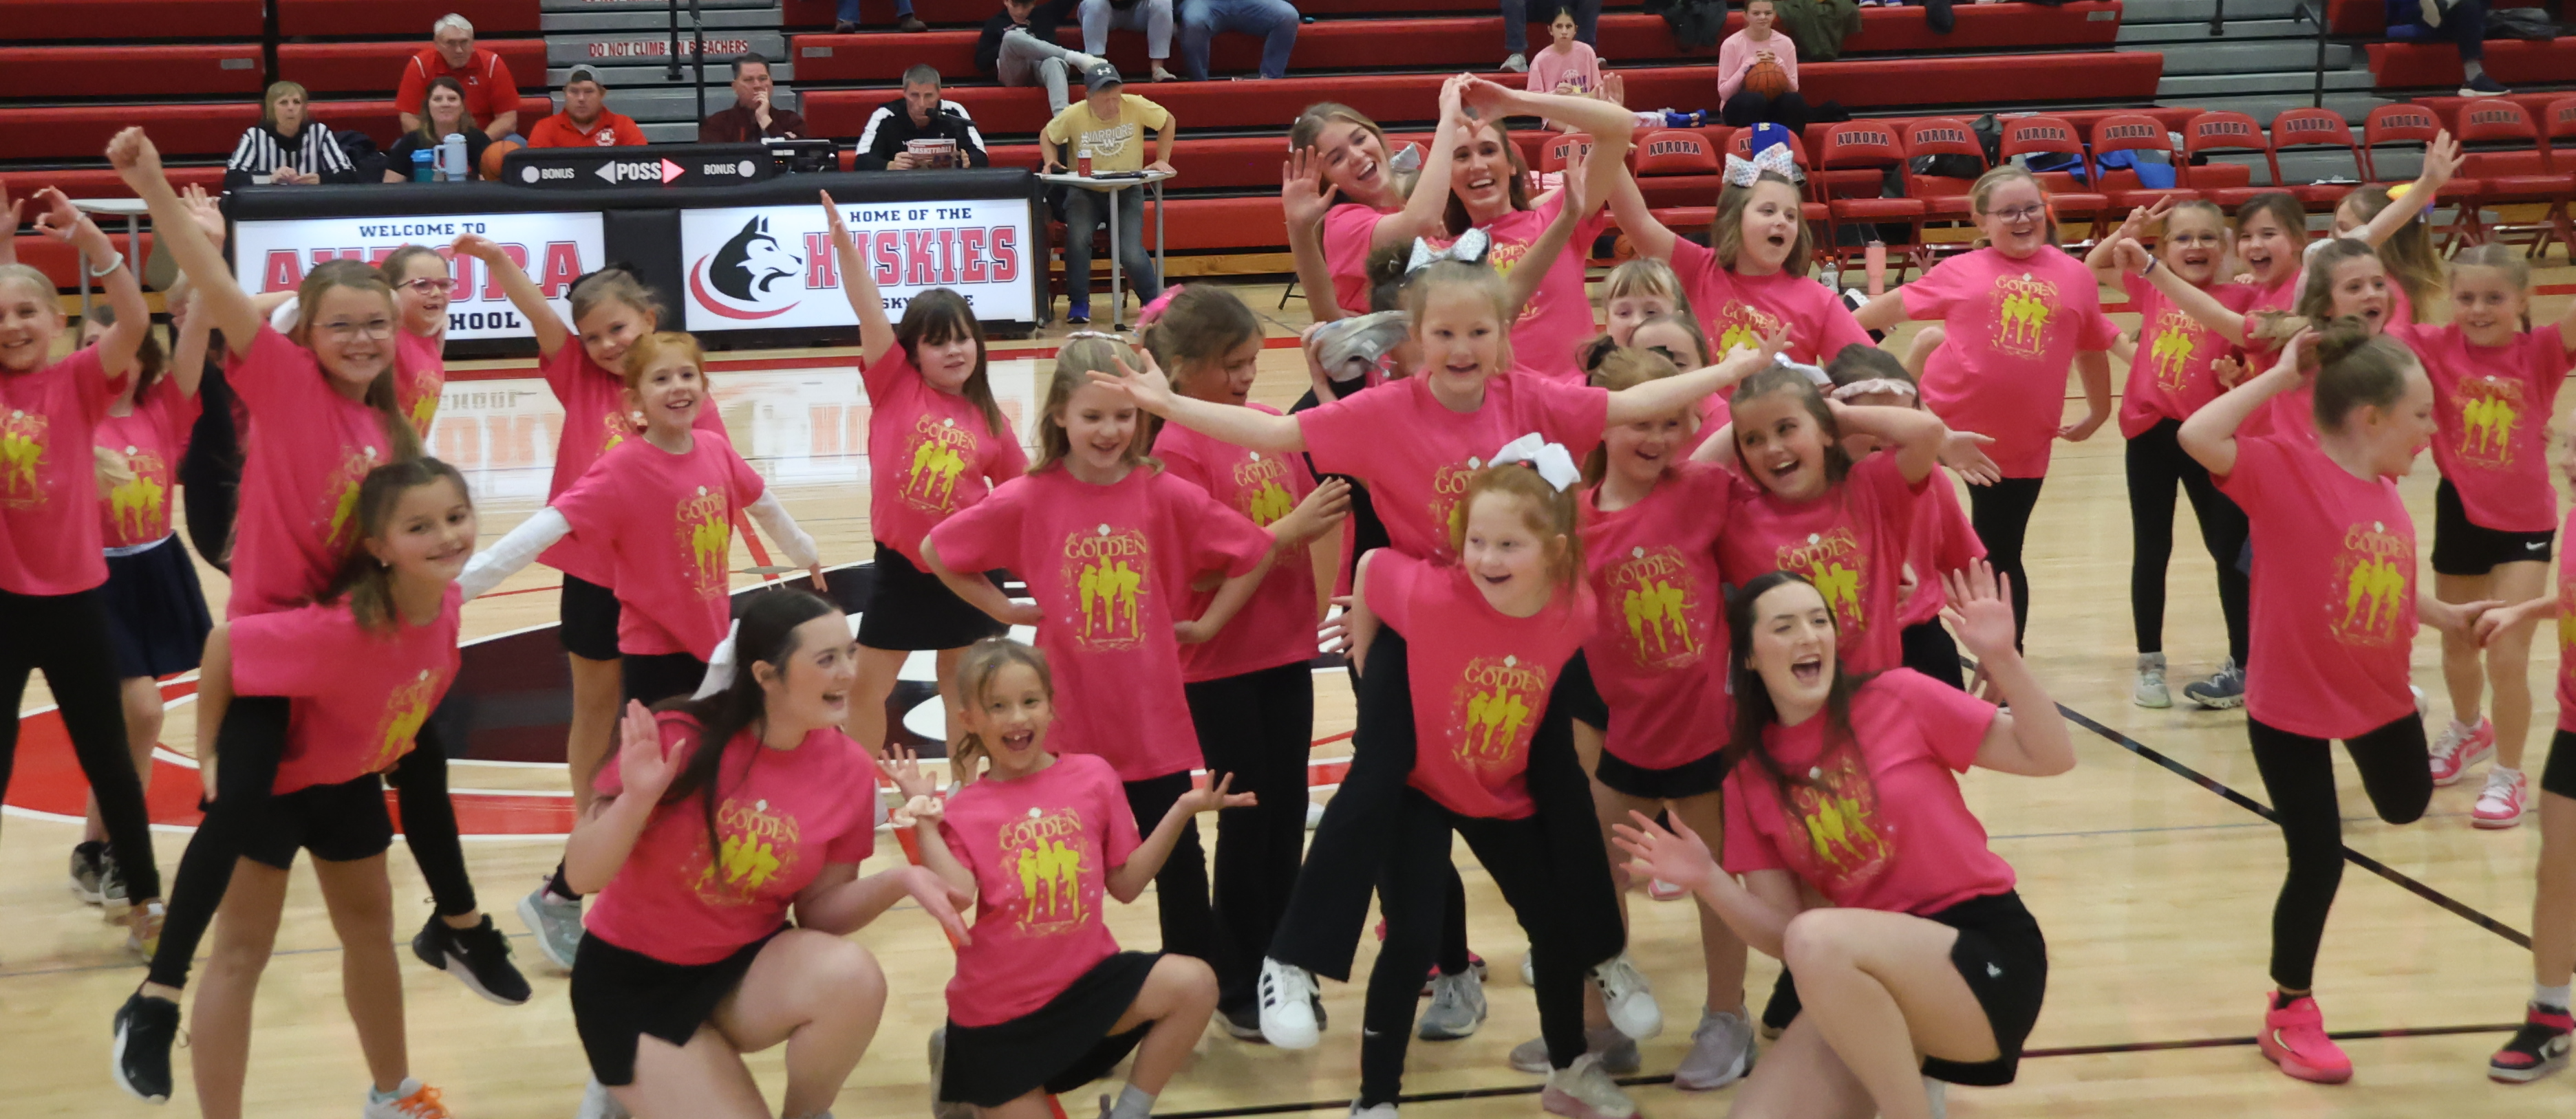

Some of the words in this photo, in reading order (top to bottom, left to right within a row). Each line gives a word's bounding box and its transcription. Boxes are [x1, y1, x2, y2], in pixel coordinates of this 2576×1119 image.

[589, 43, 603, 57] DO
[610, 42, 629, 56] NOT
[634, 41, 665, 56] CLIMB
[689, 40, 748, 55] BEACHERS
[1836, 131, 1889, 146] AURORA
[1915, 128, 1966, 144] AURORA
[2015, 127, 2066, 142] AURORA
[2105, 124, 2156, 140] AURORA
[1649, 140, 1702, 157] AURORA
[541, 168, 575, 180] BONUS
[616, 162, 662, 181] POSS
[703, 164, 736, 175] BONUS
[850, 210, 901, 223] HOME
[908, 209, 930, 221] OF
[936, 208, 972, 220] THE
[358, 224, 455, 237] WELCOME
[462, 222, 486, 235] TO
[448, 311, 522, 332] HOOL
[916, 418, 977, 451] GOLDEN
[1065, 535, 1148, 558] GOLDEN
[1777, 537, 1856, 571] GOLDEN
[1605, 554, 1684, 587] GOLDEN
[1465, 664, 1544, 691] GOLDEN
[718, 805, 798, 843] GOLDEN
[1000, 816, 1082, 850] GOLDEN
